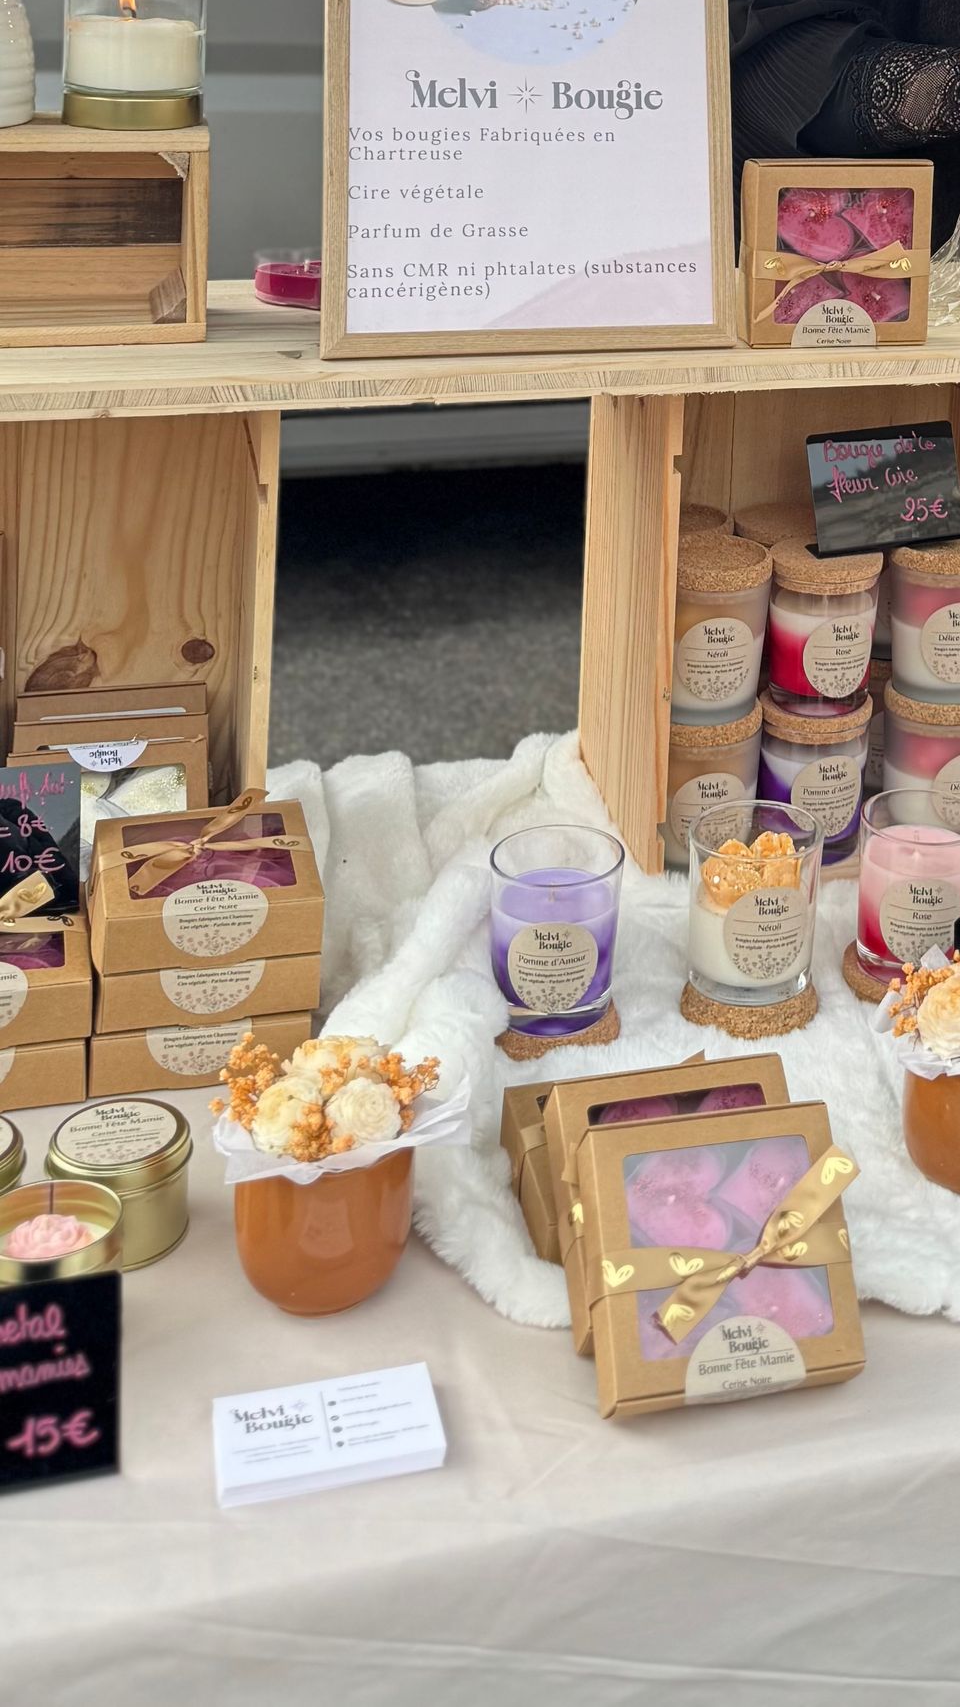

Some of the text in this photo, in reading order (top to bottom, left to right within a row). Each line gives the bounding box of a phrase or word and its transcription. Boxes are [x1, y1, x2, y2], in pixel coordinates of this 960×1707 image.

[405, 69, 663, 120] Melvi Bougie
[349, 126, 615, 146] Vos bougies Fabriquées en
[349, 146, 463, 161] Chartreuse
[348, 184, 484, 203] Cire végétale
[348, 223, 529, 239] Parfum de Grasse
[347, 259, 697, 280] Sans CMR ni phtalates (substances
[347, 281, 491, 301] cancérigènes)
[823, 439, 885, 468] Bougie
[901, 497, 948, 522] 25€
[912, 912, 932, 920] Rose
[518, 954, 548, 967] Pomme
[720, 1325, 752, 1341] Melvi
[728, 1337, 769, 1355] Bougie
[698, 1352, 795, 1376] Bonne Fête Mamie
[722, 1375, 772, 1390] Cerise Noire
[229, 1404, 286, 1424] Melvi
[245, 1413, 314, 1434] Bougie
[7, 1408, 101, 1457] 15€
